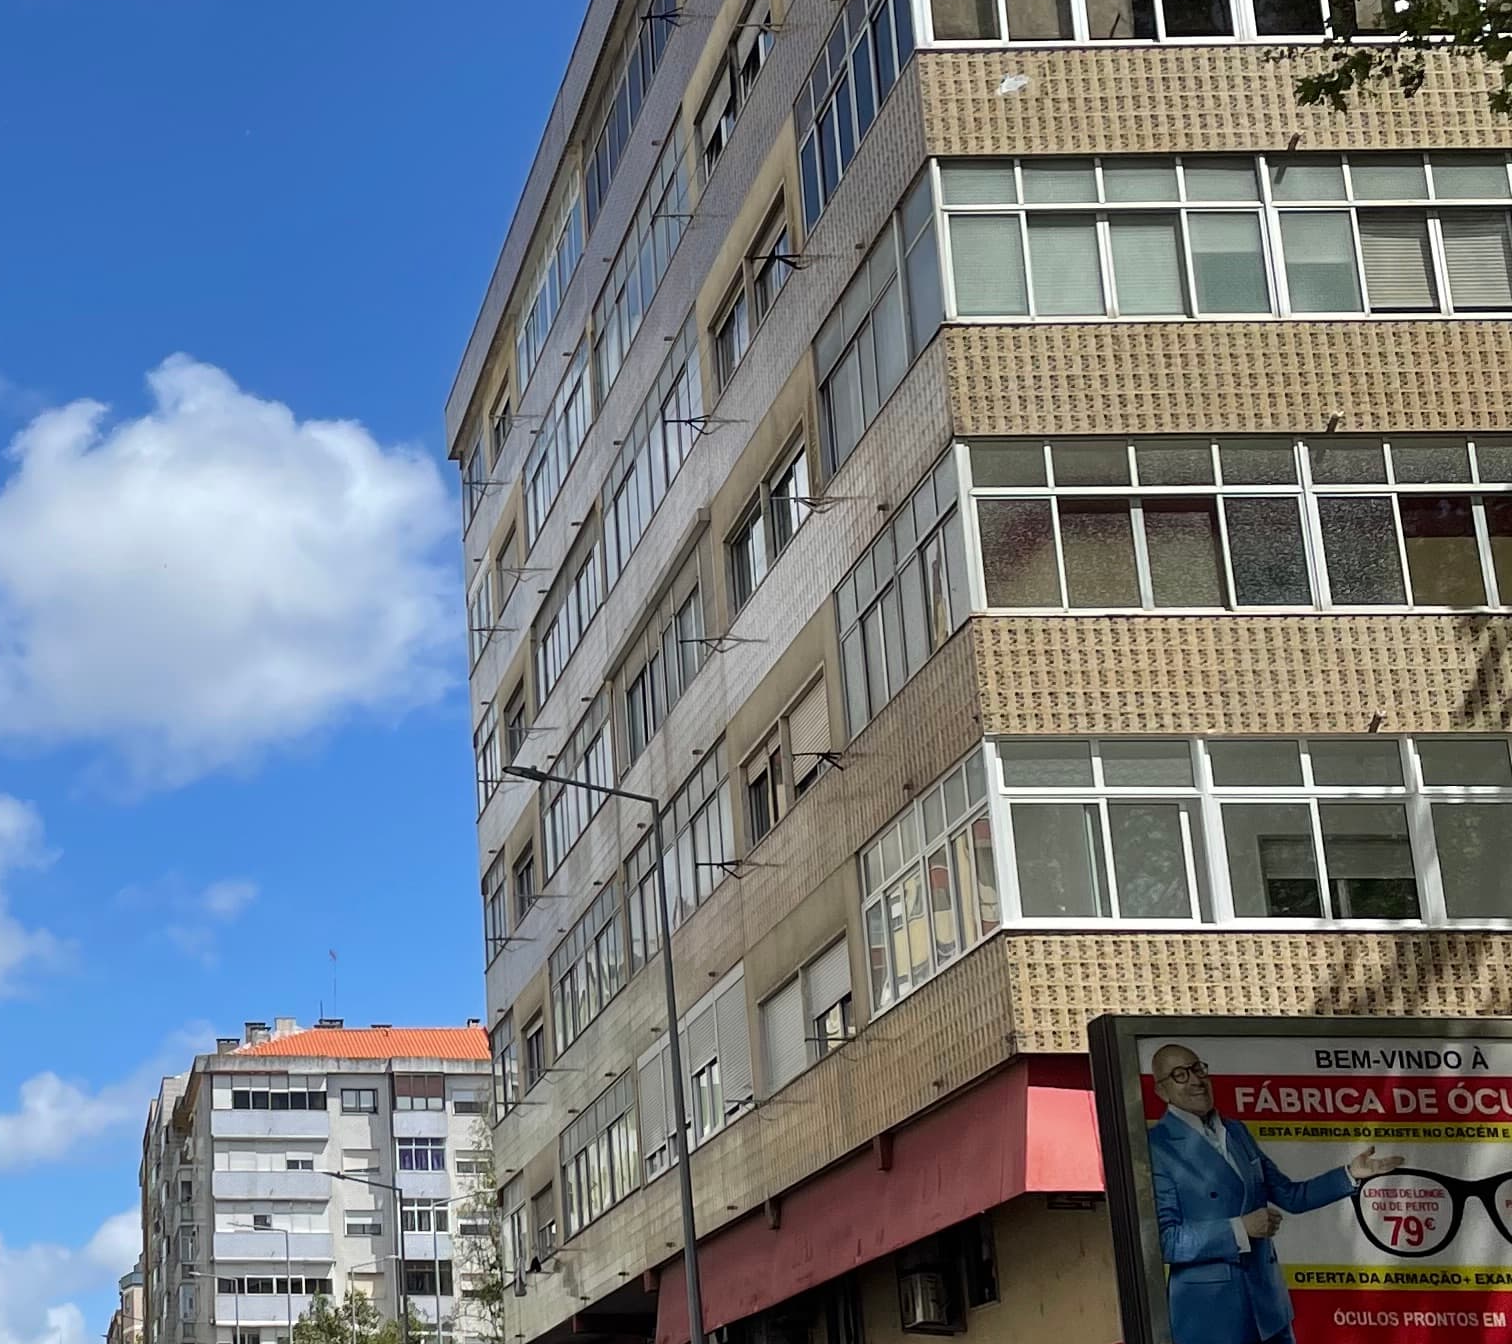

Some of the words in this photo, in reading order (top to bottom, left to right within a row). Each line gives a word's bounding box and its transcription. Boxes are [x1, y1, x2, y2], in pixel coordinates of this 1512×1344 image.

[1315, 1049, 1462, 1070] BEM-VINDO
[1471, 1046, 1489, 1070] À
[1235, 1081, 1386, 1114] FÁBRICA
[1393, 1088, 1439, 1114] DE
[1259, 1126, 1293, 1137] ESTA
[1294, 1124, 1350, 1138] FÁBRICA
[1374, 1127, 1420, 1138] EXISTE
[1423, 1127, 1442, 1138] NO
[1363, 1188, 1398, 1199] LENTES
[1399, 1188, 1412, 1199] DE
[1372, 1201, 1387, 1212] OU
[1388, 1201, 1403, 1212] DE
[1405, 1202, 1439, 1212] PERTO
[1383, 1216, 1436, 1247] 79€
[1295, 1271, 1355, 1284] OFERTA
[1359, 1271, 1378, 1284] DA
[1334, 1308, 1399, 1327] ÓCULOS
[1403, 1312, 1478, 1327] PRONTOS
[1483, 1311, 1506, 1327] EM
